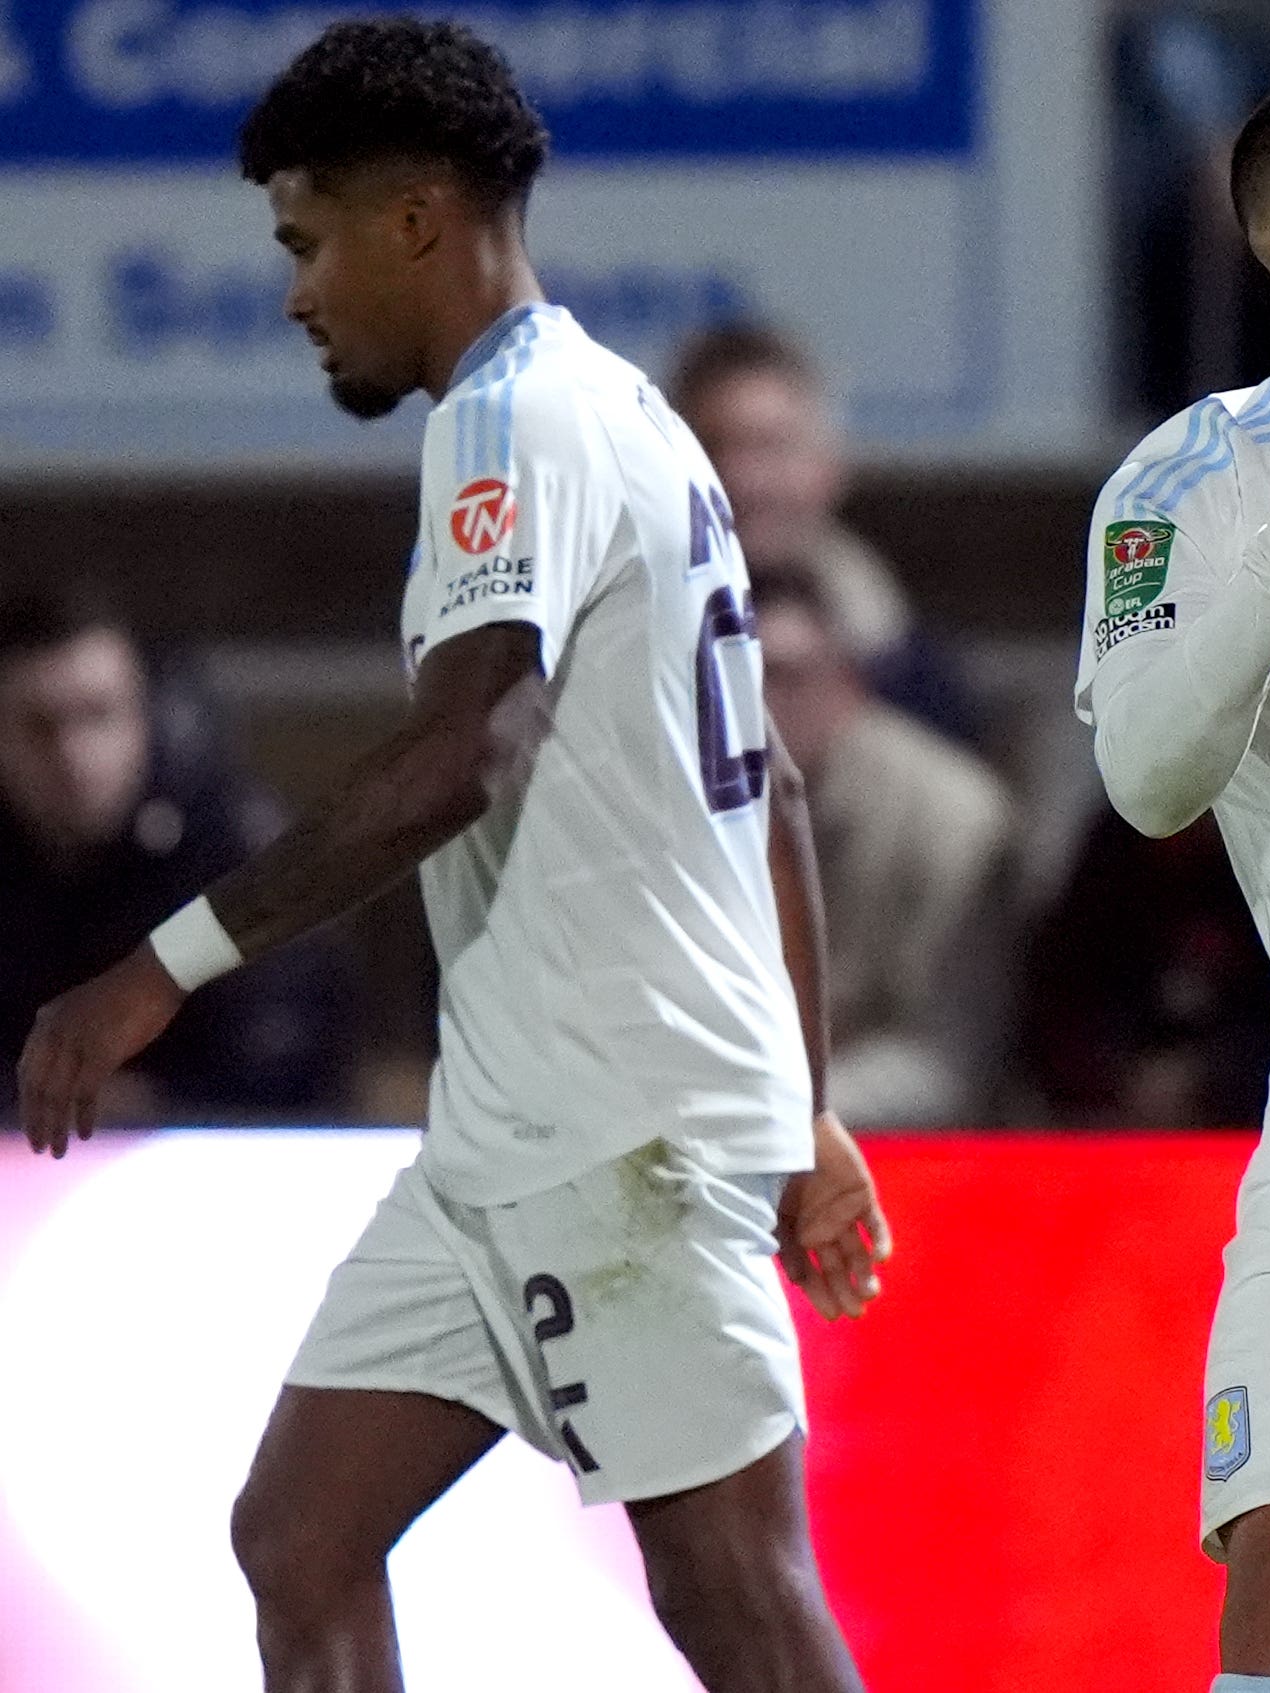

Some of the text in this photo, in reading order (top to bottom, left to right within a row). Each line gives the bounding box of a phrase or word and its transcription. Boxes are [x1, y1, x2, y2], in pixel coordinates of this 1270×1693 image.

[72, 0, 930, 103] Coercial
[446, 556, 534, 597] TRADE
[1109, 556, 1166, 580] arabao
[1113, 571, 1143, 591] Cup
[439, 579, 535, 617] NATION
[1109, 616, 1175, 647] racism
